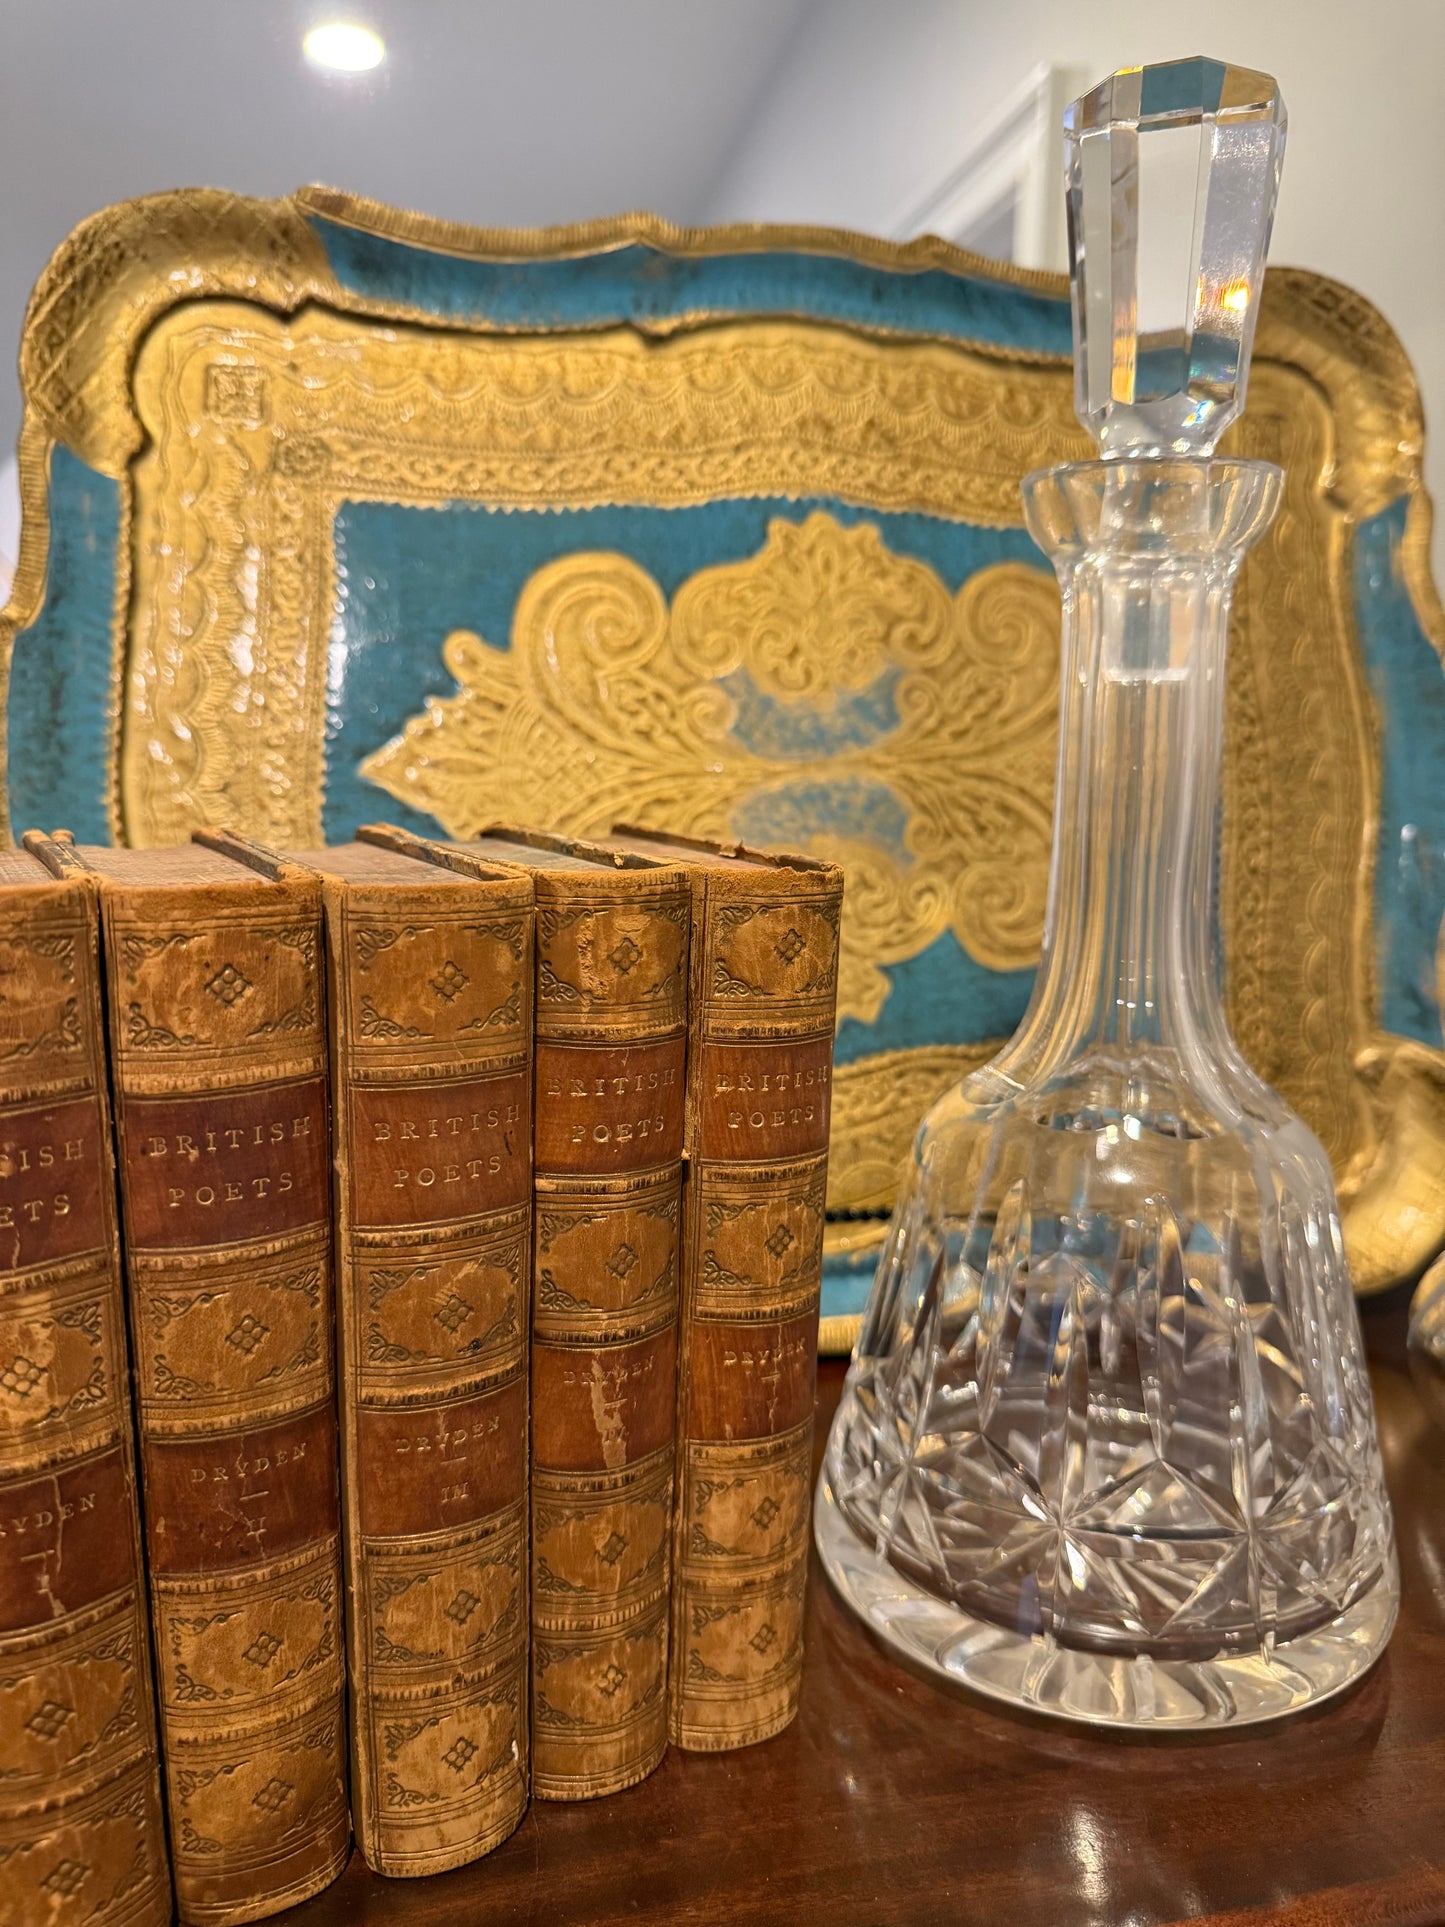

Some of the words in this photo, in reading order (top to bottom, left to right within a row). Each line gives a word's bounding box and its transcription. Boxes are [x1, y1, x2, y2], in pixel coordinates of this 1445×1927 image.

[547, 1067, 676, 1098] BRITISH
[715, 1065, 829, 1094] BRITISH
[374, 1103, 521, 1141] BRITISH
[571, 1115, 665, 1144] POETS
[727, 1104, 816, 1129] POETS
[148, 1115, 311, 1157] BRITISH
[168, 1171, 293, 1208] POETS
[393, 1155, 502, 1189] POETS
[395, 1415, 500, 1453] DRYDEN
[191, 1442, 307, 1483] DRYDEN
